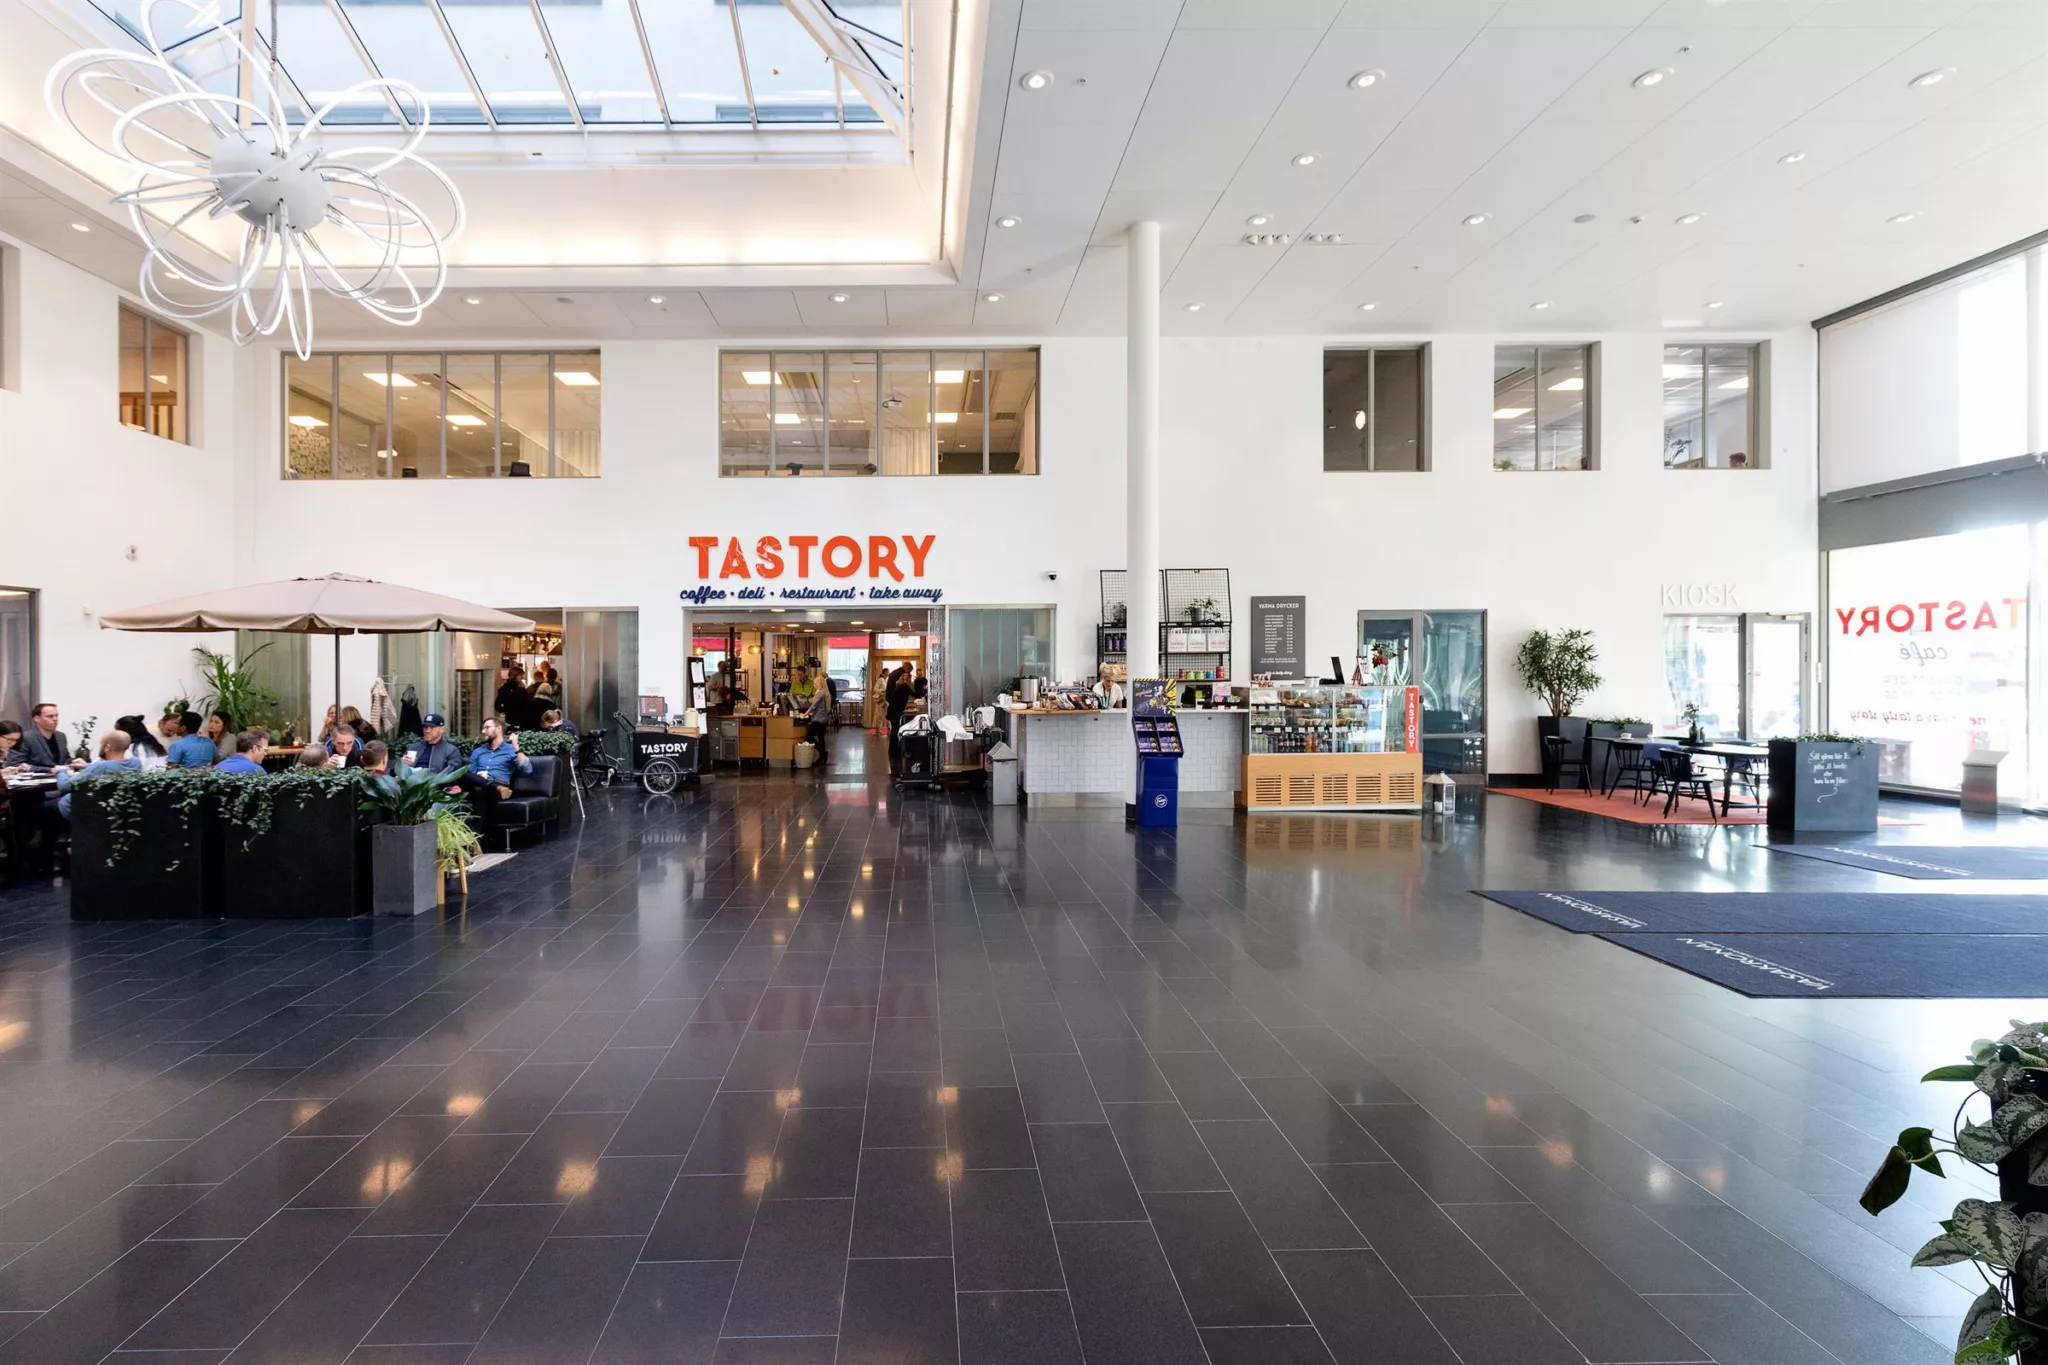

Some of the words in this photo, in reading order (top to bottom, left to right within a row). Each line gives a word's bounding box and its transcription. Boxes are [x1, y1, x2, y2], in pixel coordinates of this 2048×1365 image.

[689, 535, 936, 582] TASTORY
[680, 585, 727, 604] coffee
[737, 585, 766, 599] deli
[779, 585, 857, 599] restaurant
[868, 585, 901, 599] take
[902, 588, 943, 603] away
[1661, 583, 1740, 606] KIOSK
[1408, 693, 1416, 748] TASTORY
[640, 743, 688, 754] TASTORY
[1676, 938, 1830, 990] VASAKRONAN
